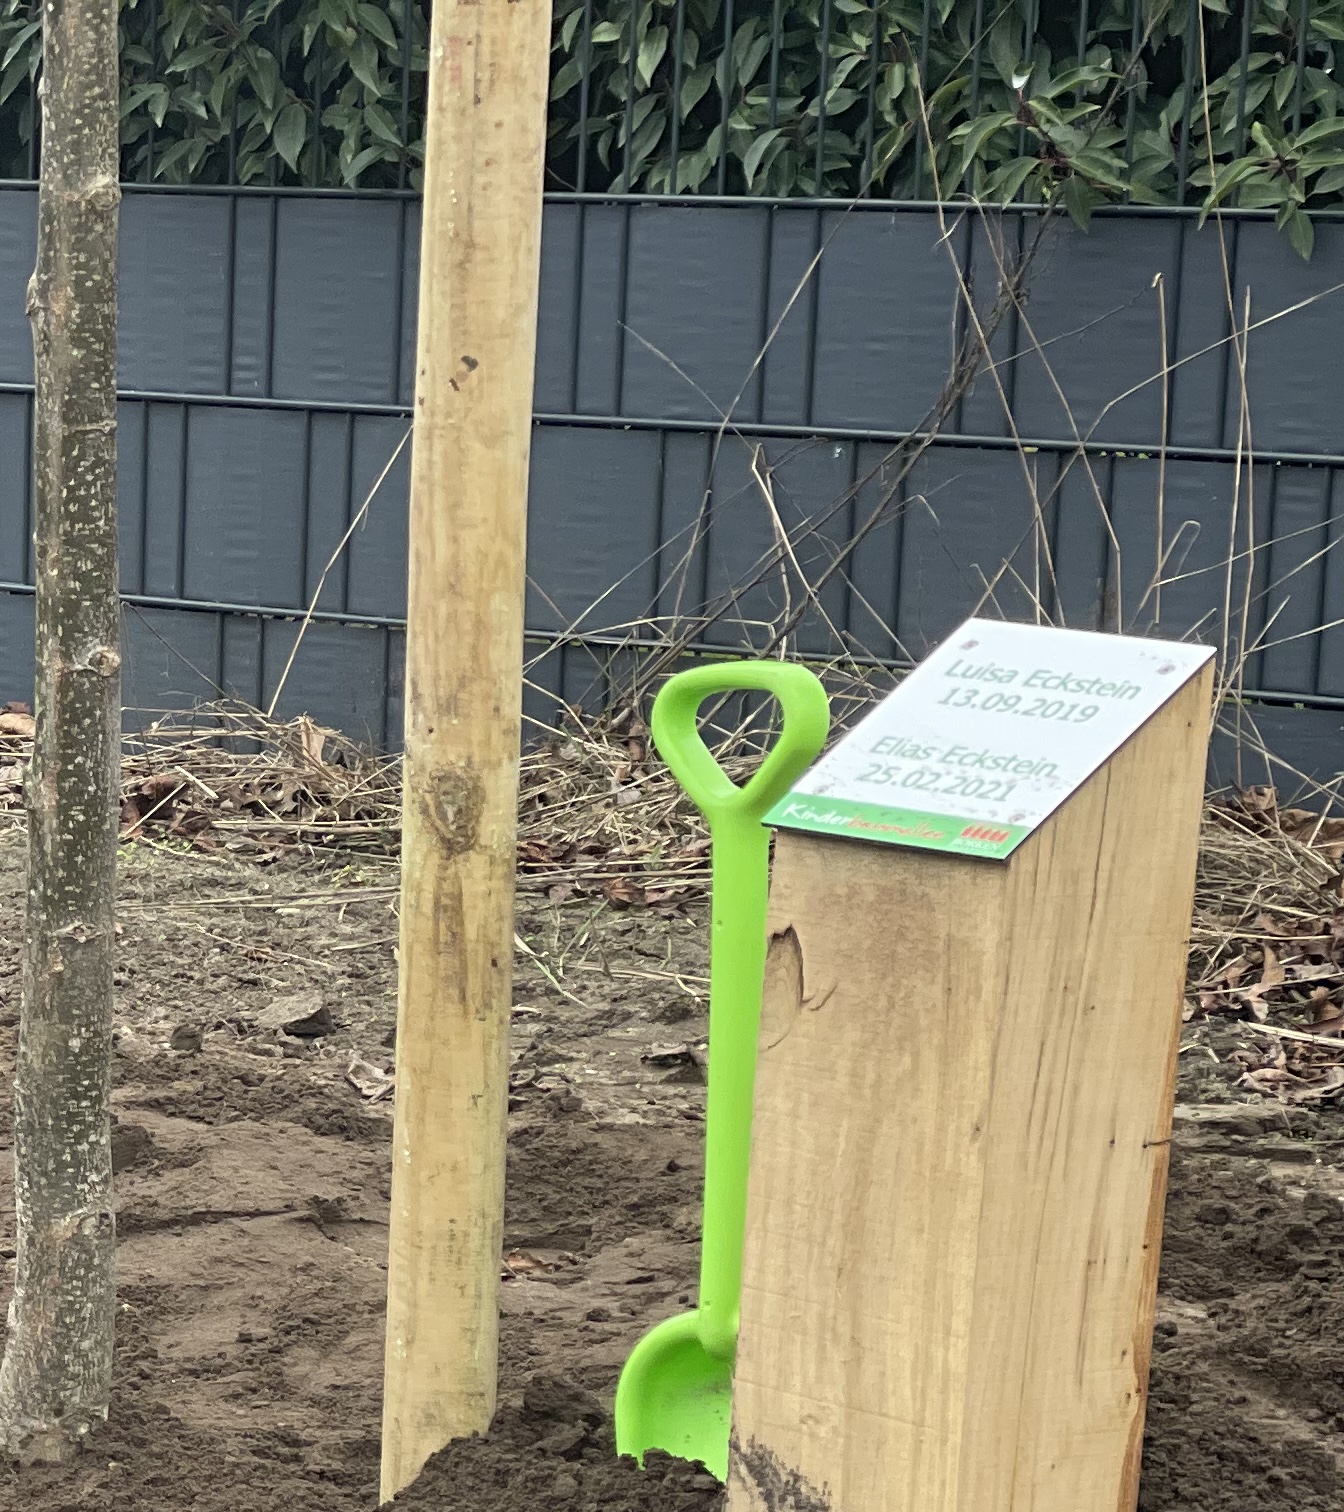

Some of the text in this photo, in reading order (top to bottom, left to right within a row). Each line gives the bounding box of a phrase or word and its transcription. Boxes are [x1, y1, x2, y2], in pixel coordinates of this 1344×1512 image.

[945, 659, 1142, 700] Luisa Eckstein
[937, 687, 1100, 723] 13.09.2019
[869, 736, 1059, 778] Elias Eckstein
[857, 763, 1017, 802] 25.02.2021
